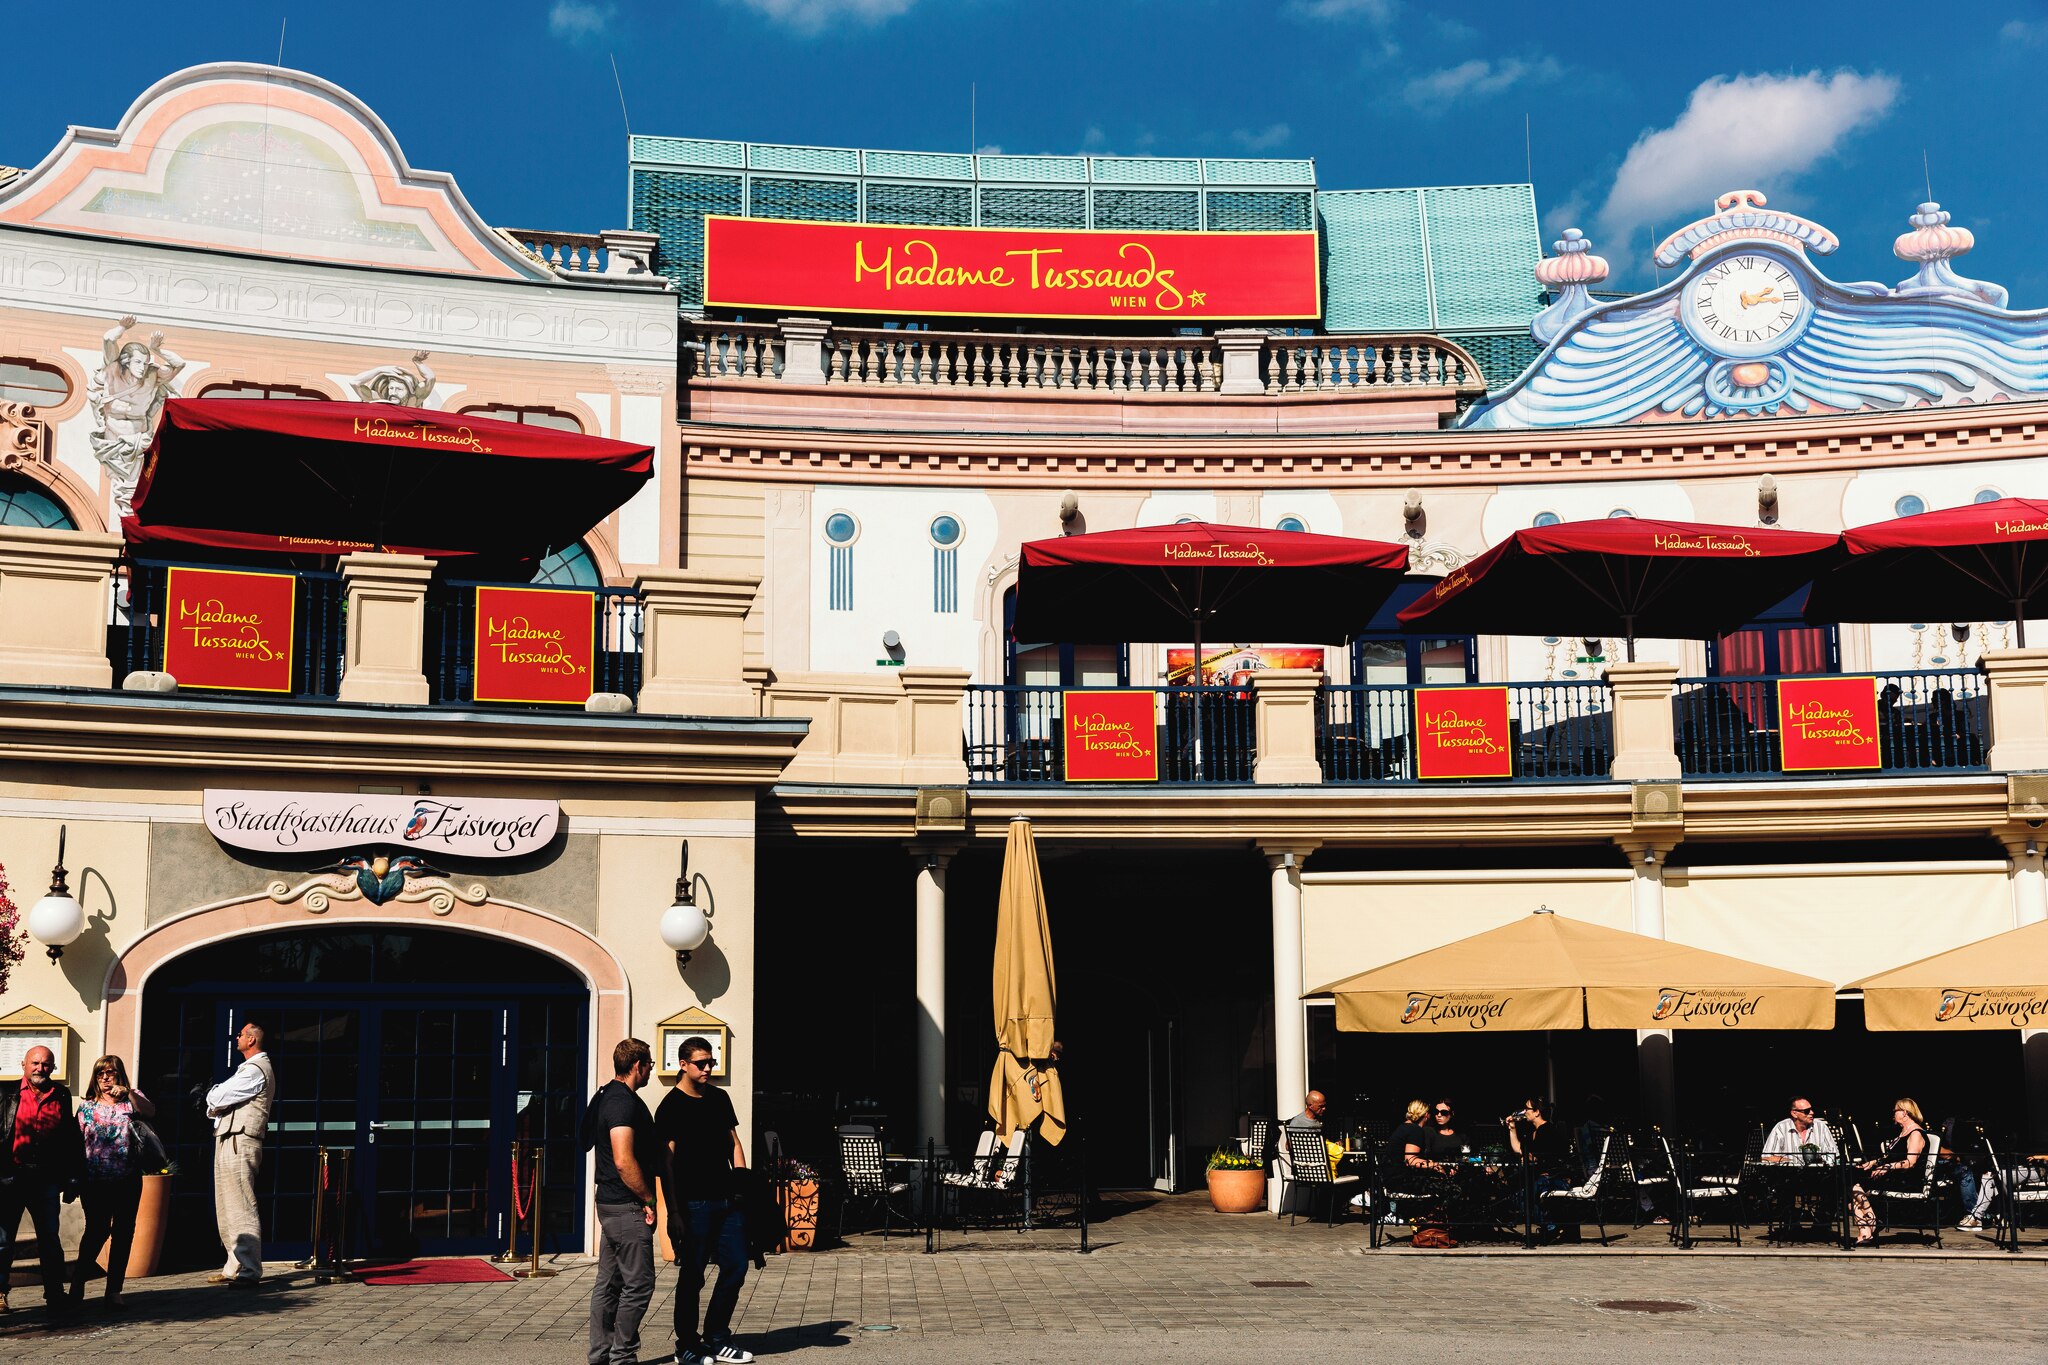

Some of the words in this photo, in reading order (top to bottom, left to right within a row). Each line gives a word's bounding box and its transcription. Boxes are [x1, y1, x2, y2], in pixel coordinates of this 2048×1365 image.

[855, 240, 1015, 291] Madame
[1006, 242, 1184, 311] Tussauds
[1110, 296, 1147, 308] WIEN
[354, 418, 418, 438] Madame
[413, 424, 484, 453] Tussauds
[1995, 519, 2048, 536] Madame
[1164, 542, 1216, 560] Madame
[1211, 542, 1268, 566] Tussauds
[1655, 534, 1705, 551] Madame
[1699, 535, 1754, 557] Tussauds
[180, 599, 263, 625] Madame
[488, 616, 565, 641] Madame
[182, 625, 274, 661] Tussauds
[490, 641, 576, 675] Tussauds
[1074, 712, 1134, 733] Madame
[1425, 709, 1487, 731] Madame
[1788, 701, 1854, 722] Madame
[1076, 731, 1143, 758] Tussauds
[1428, 728, 1497, 755] Tussauds
[1792, 718, 1865, 746] Tussauds
[215, 803, 403, 847] Stadtgasthaus
[404, 799, 551, 852] Eisvogel
[1401, 991, 1513, 1029] Eisvogel
[1652, 987, 1766, 1027] Eisvogel
